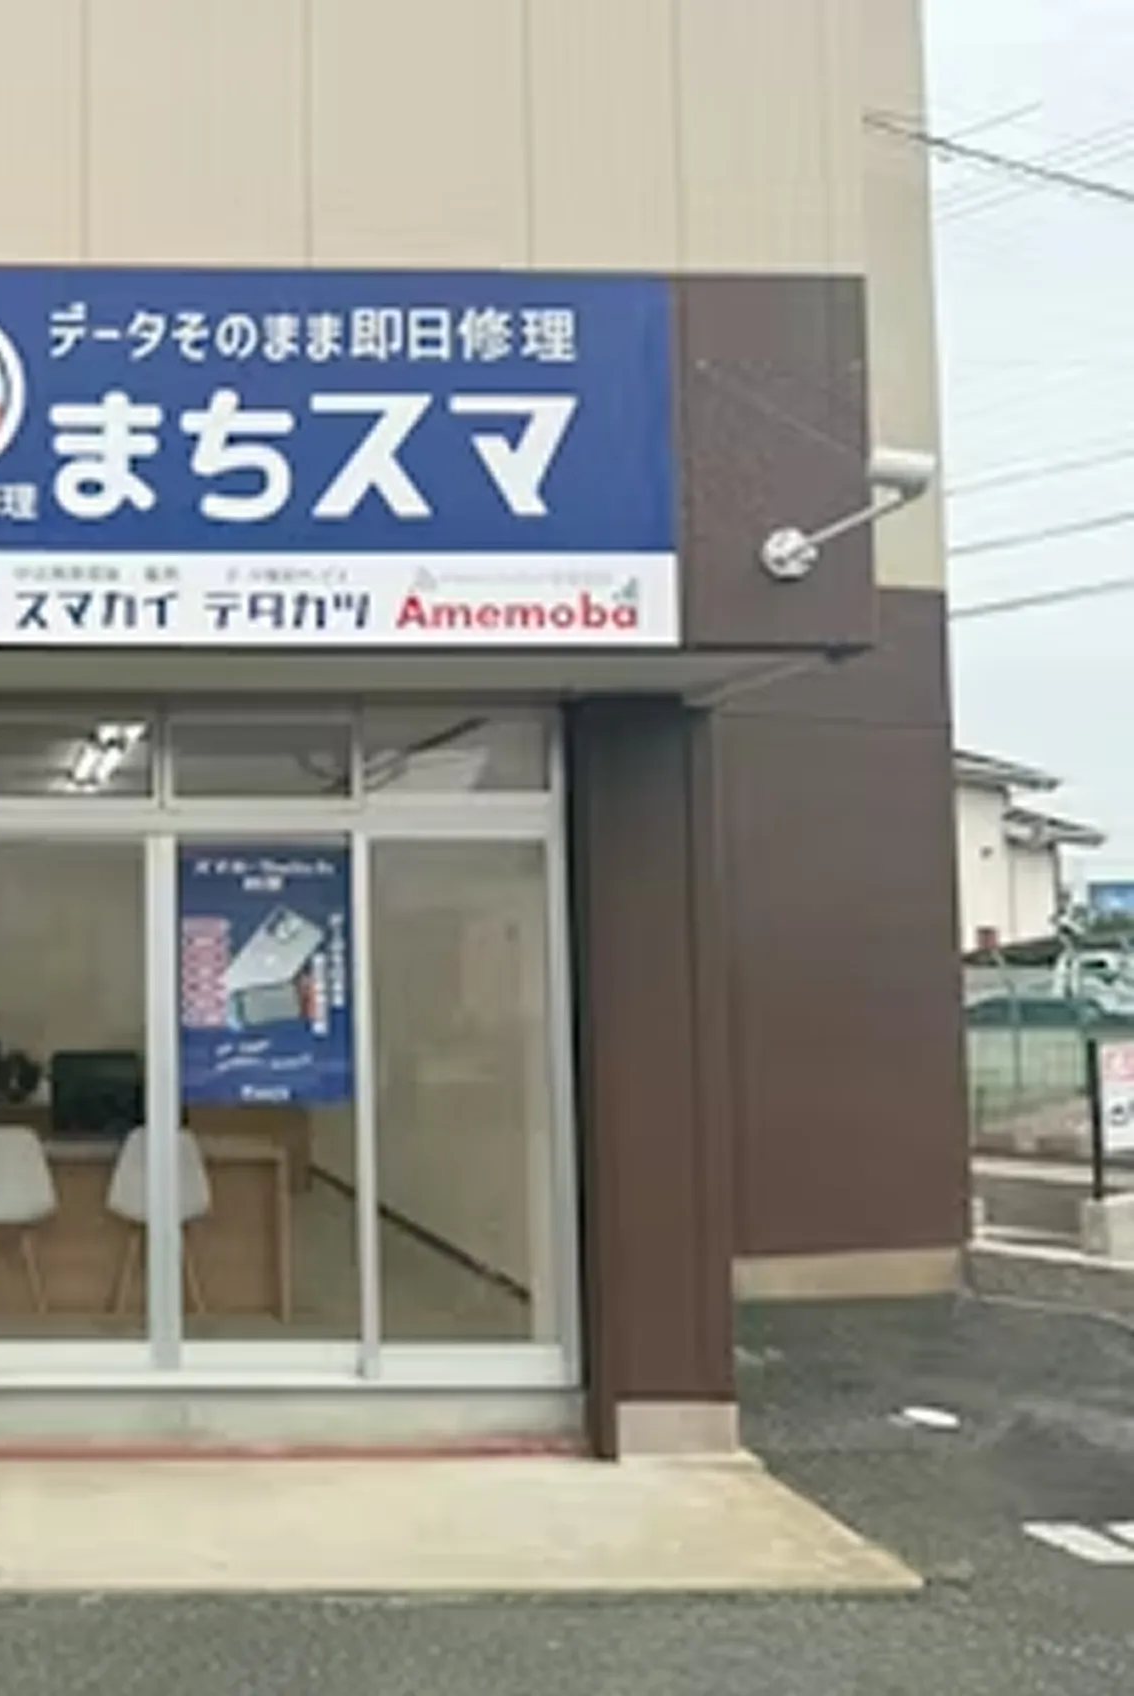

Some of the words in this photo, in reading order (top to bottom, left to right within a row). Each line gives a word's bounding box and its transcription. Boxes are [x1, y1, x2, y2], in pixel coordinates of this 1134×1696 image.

[50, 302, 578, 360] データそのまま即日修理
[49, 389, 578, 520] まちスマ
[395, 593, 639, 631] Amemoba
